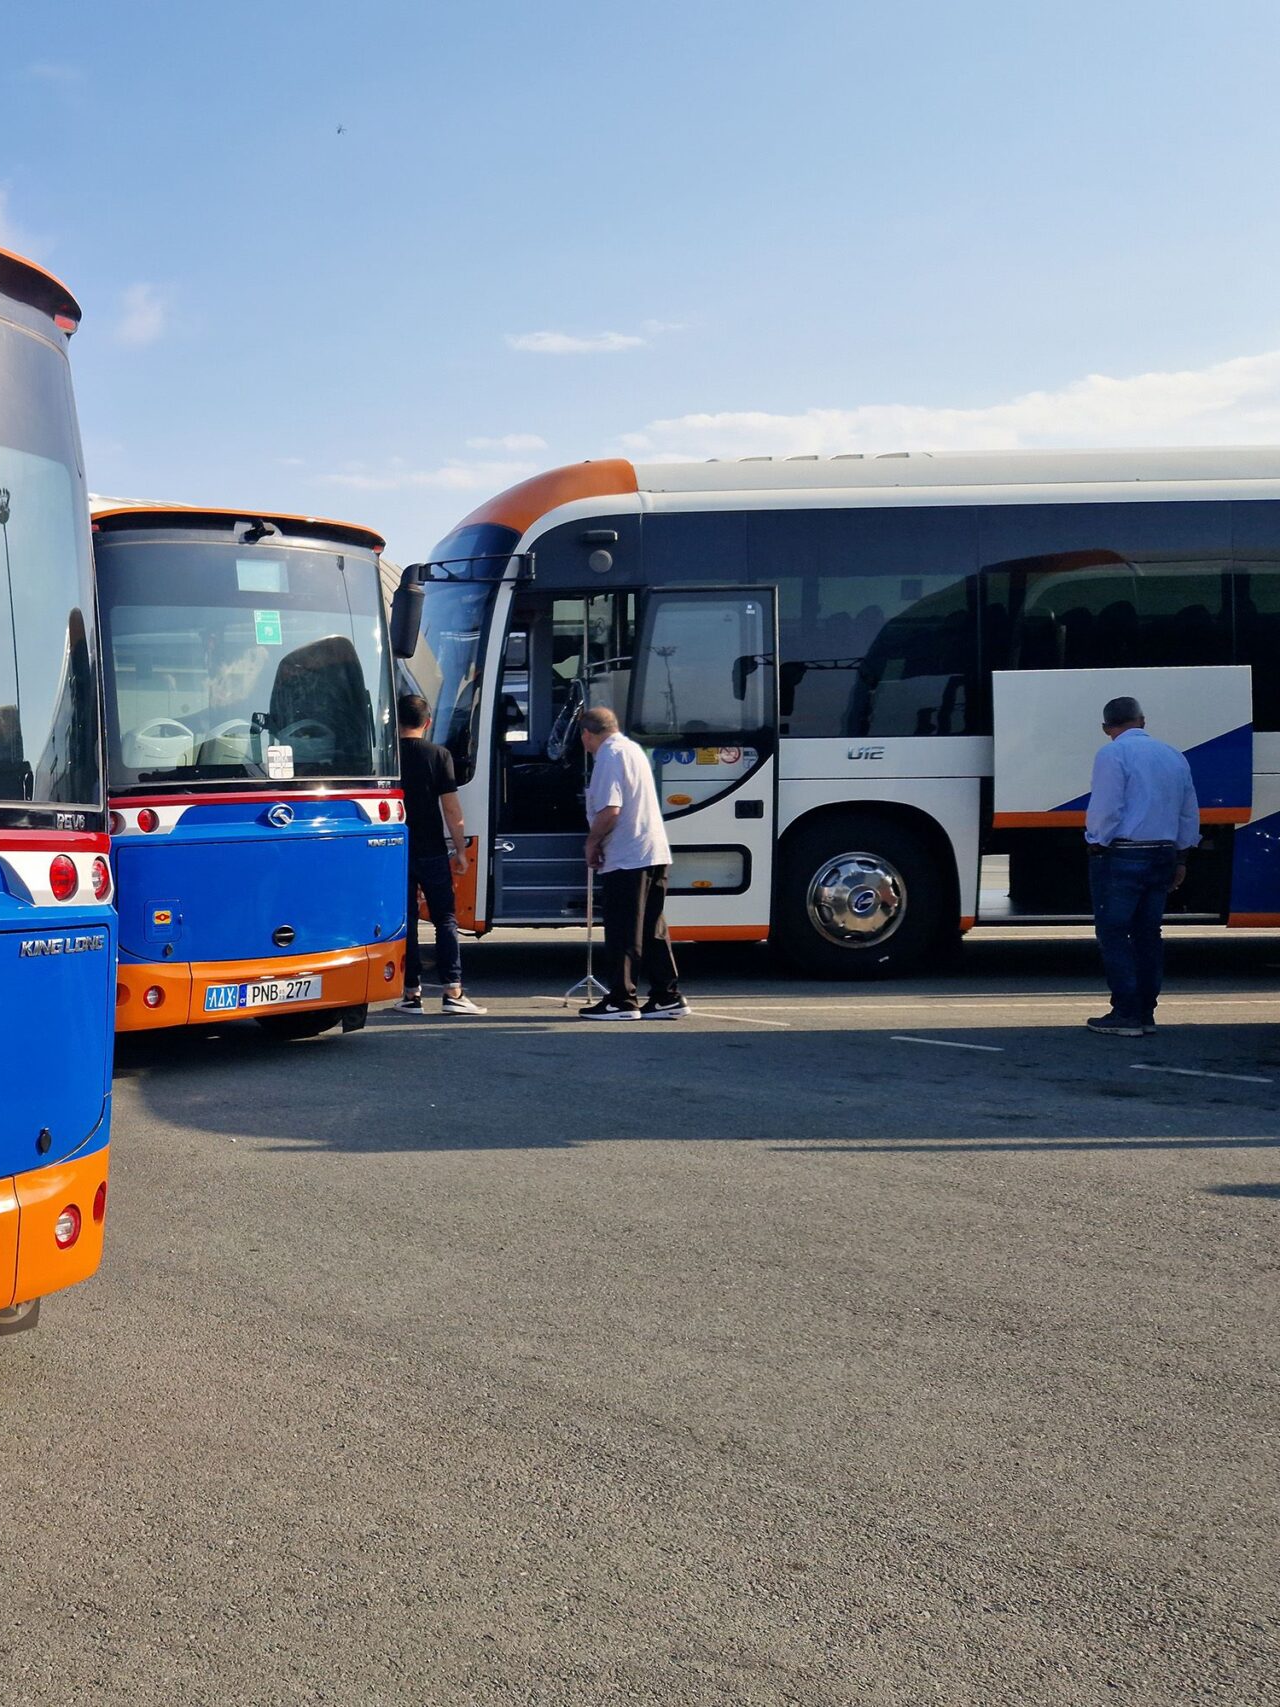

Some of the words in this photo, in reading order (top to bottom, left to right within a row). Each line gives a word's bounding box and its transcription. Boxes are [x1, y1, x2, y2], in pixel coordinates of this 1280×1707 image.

[20, 937, 63, 957] KING
[64, 934, 105, 952] LONG
[252, 984, 279, 1003] PNB
[286, 980, 311, 999] 277
